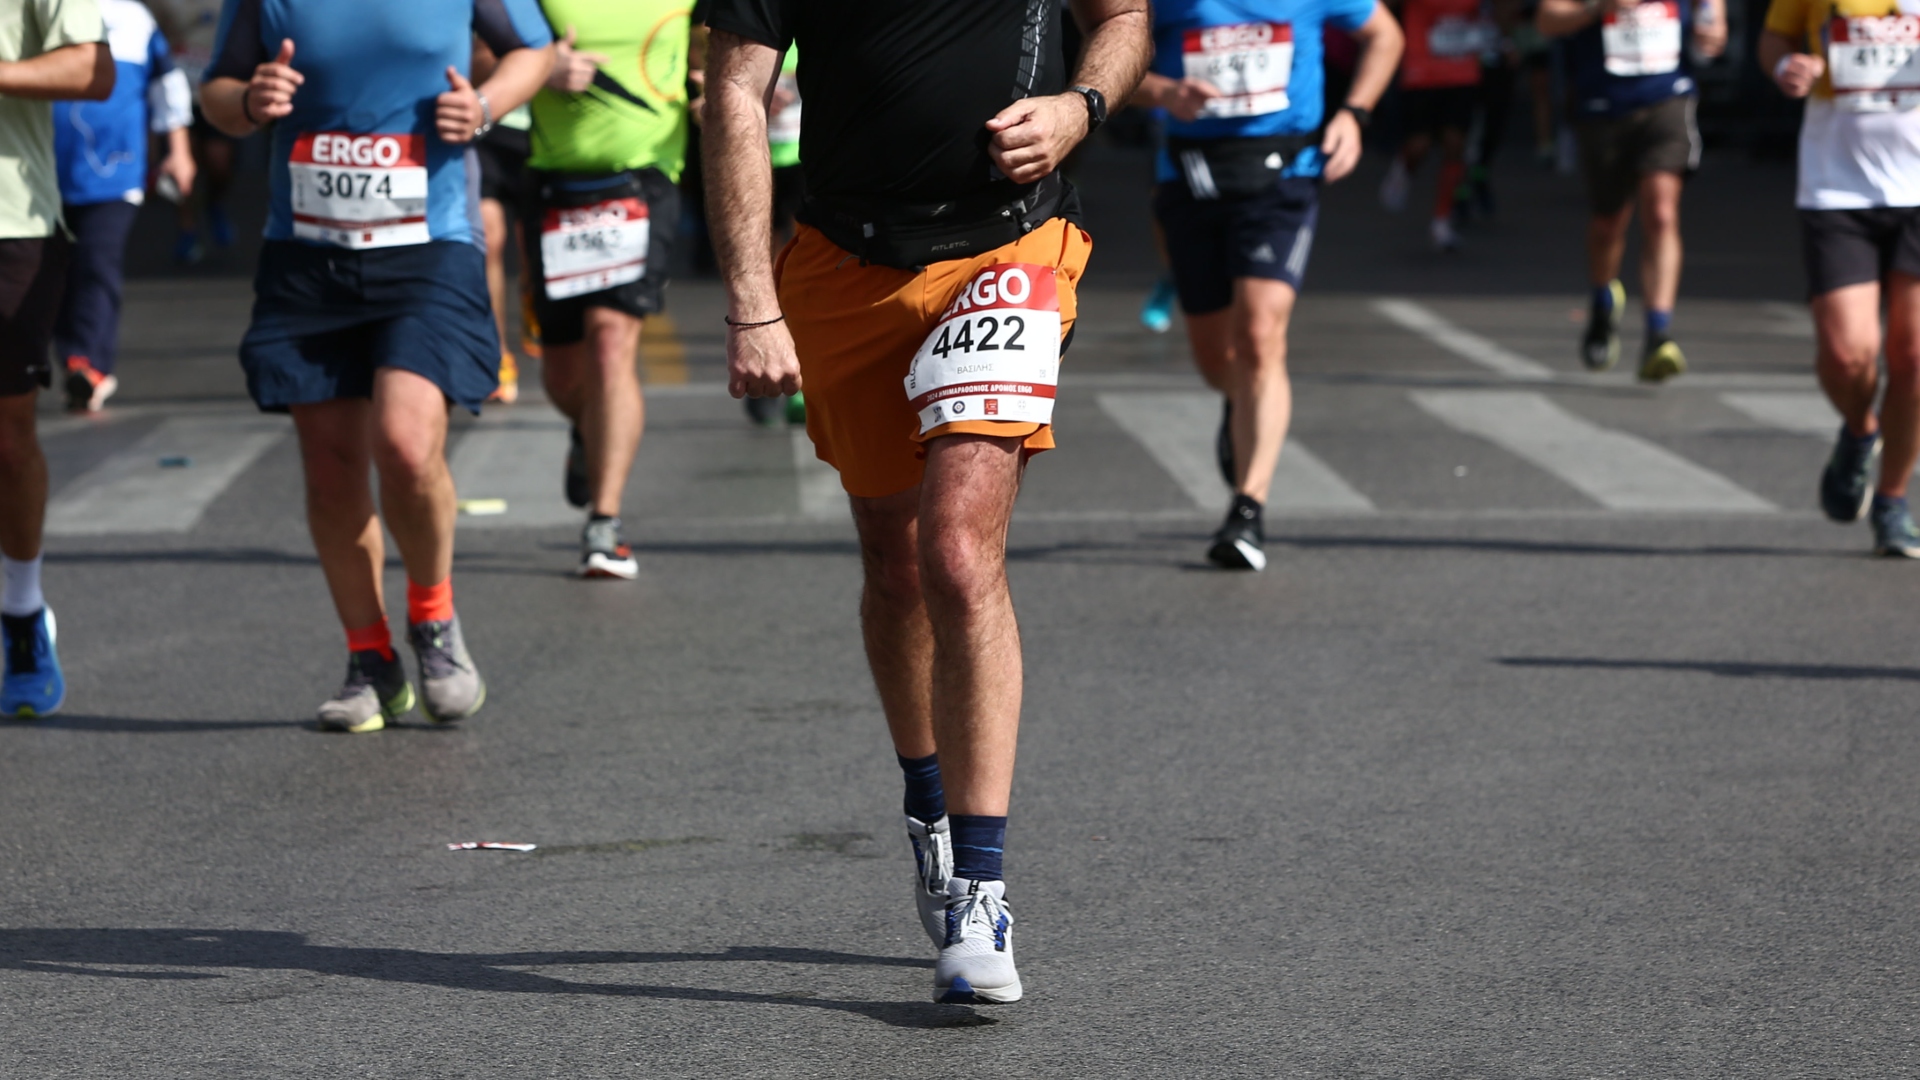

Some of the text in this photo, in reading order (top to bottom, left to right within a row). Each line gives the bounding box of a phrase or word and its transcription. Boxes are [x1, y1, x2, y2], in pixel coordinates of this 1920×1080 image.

[312, 134, 401, 167] ERGO
[316, 170, 392, 200] 3074
[932, 315, 1026, 359] 4422
[957, 363, 994, 375] ΒΑΣΙΛΗΣ
[926, 393, 938, 402] 2024
[990, 384, 1017, 393] ΔΡΟΜΟΣ
[1017, 385, 1033, 393] ERGO
